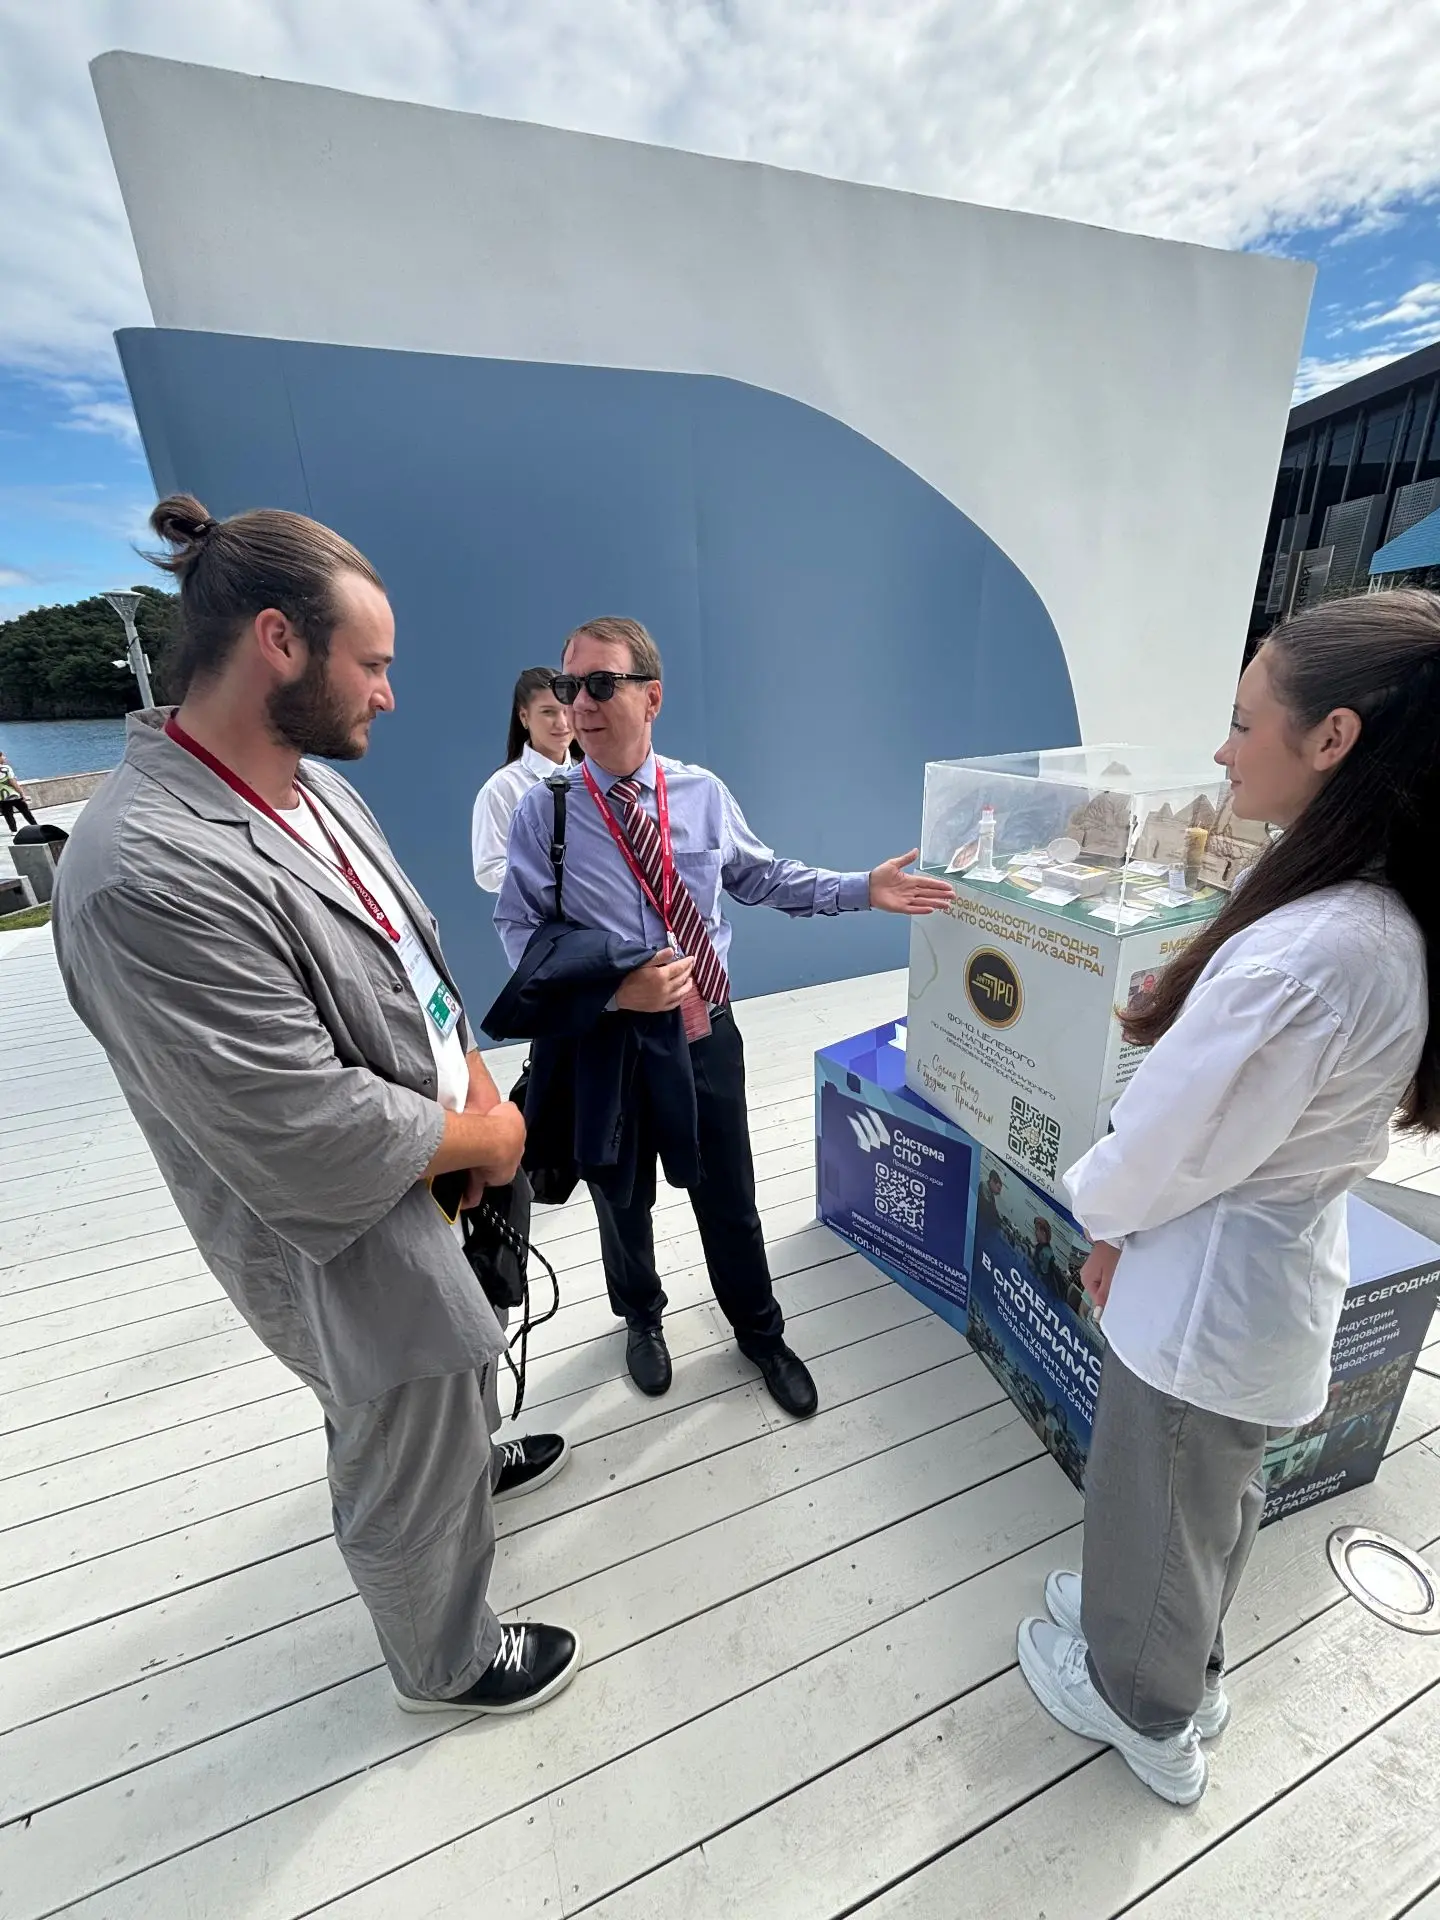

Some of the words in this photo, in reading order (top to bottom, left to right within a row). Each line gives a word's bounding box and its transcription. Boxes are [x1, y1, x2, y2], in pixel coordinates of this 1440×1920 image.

[957, 909, 977, 926] КТО
[979, 918, 1031, 947] СОЗДАЁТ
[1031, 939, 1048, 956] ИХ
[1050, 946, 1104, 977] ЗАВТРА!
[1038, 926, 1099, 959] СЕГОДНЯ
[947, 1012, 975, 1033] ФОНД
[976, 1029, 1036, 1068] ЦЕЛЕВОГО
[961, 1031, 1016, 1069] КАПИТАЛА
[892, 1144, 922, 1167] СПО
[893, 1129, 945, 1163] Система
[853, 1232, 881, 1257] ТОП-10
[1368, 1270, 1440, 1303] СЕГОДНЯ
[981, 1251, 992, 1272] В
[993, 1267, 1026, 1313] СПО
[1028, 1308, 1099, 1397] ПРИМО
[1010, 1267, 1102, 1377] СДЕЛАНО
[1332, 1319, 1398, 1350] орудование
[993, 1285, 1018, 1322] Наши
[1019, 1322, 1069, 1384] студенты
[1071, 1382, 1097, 1412] уча
[997, 1305, 1041, 1363] создавая
[1042, 1361, 1093, 1426] настоящ
[1261, 1506, 1280, 1520] ОЙ
[1280, 1482, 1341, 1513] РАБОТЫ
[1264, 1496, 1284, 1509] ГО
[1284, 1470, 1347, 1501] НАВЫКА
